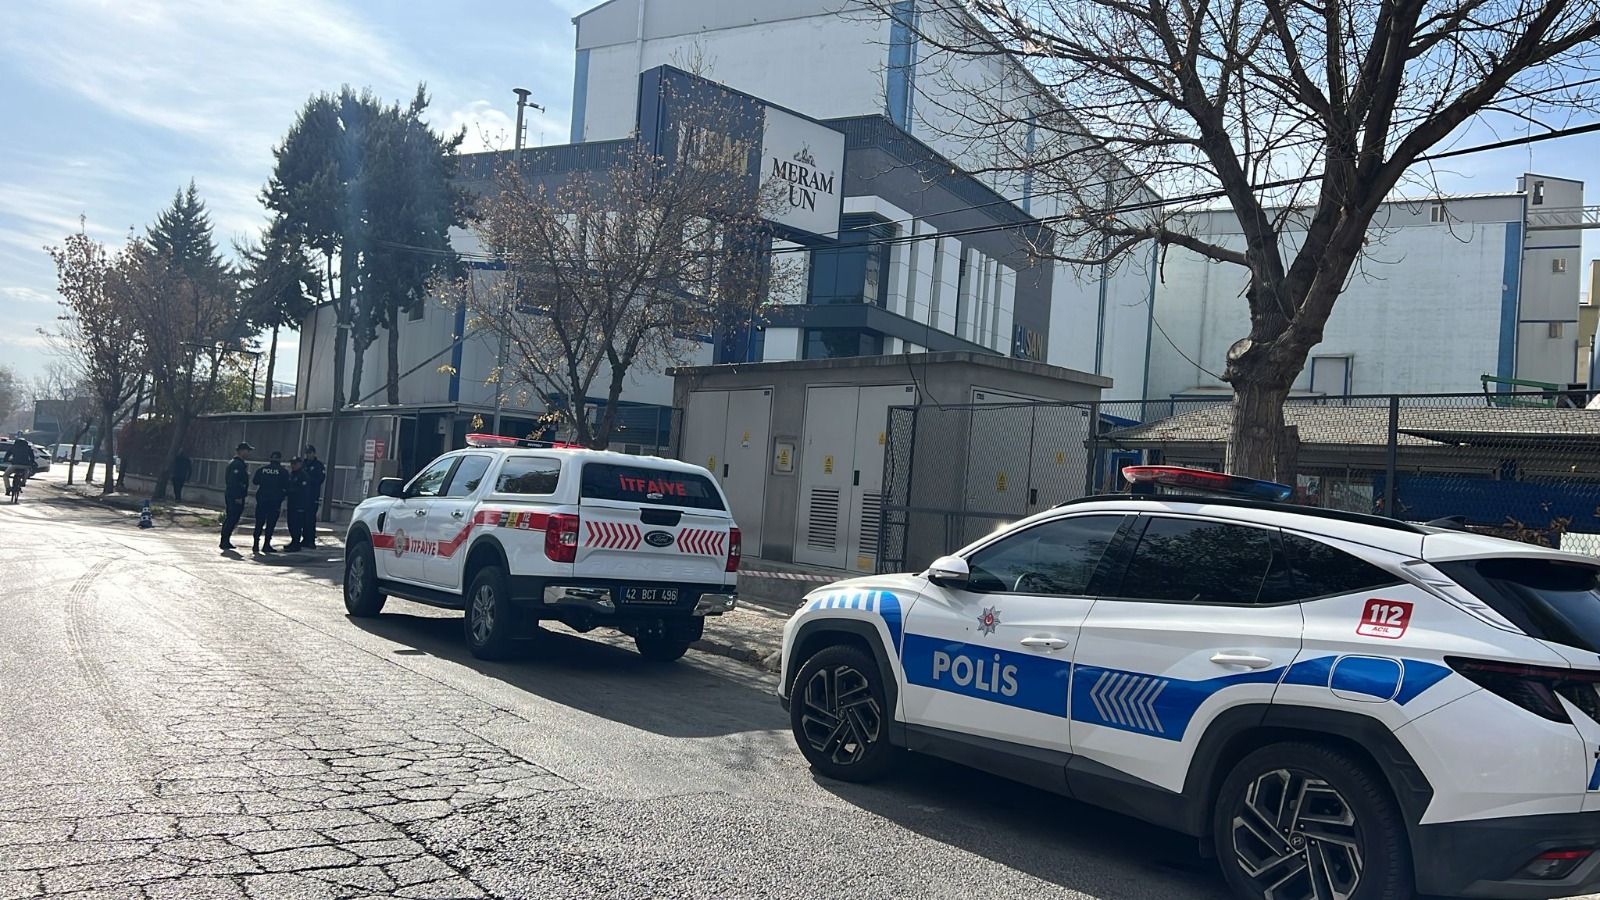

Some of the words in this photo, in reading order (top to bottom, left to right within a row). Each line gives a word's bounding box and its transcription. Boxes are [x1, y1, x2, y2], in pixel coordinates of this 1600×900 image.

[772, 157, 834, 195] MERAM
[788, 182, 816, 212] UN
[619, 474, 687, 496] İTFAİYE
[410, 536, 437, 556] İTFAİYE
[626, 589, 636, 600] 42
[641, 589, 656, 600] BCT
[661, 589, 677, 601] 496
[1370, 604, 1404, 625] 112
[932, 650, 1018, 697] POLİS
